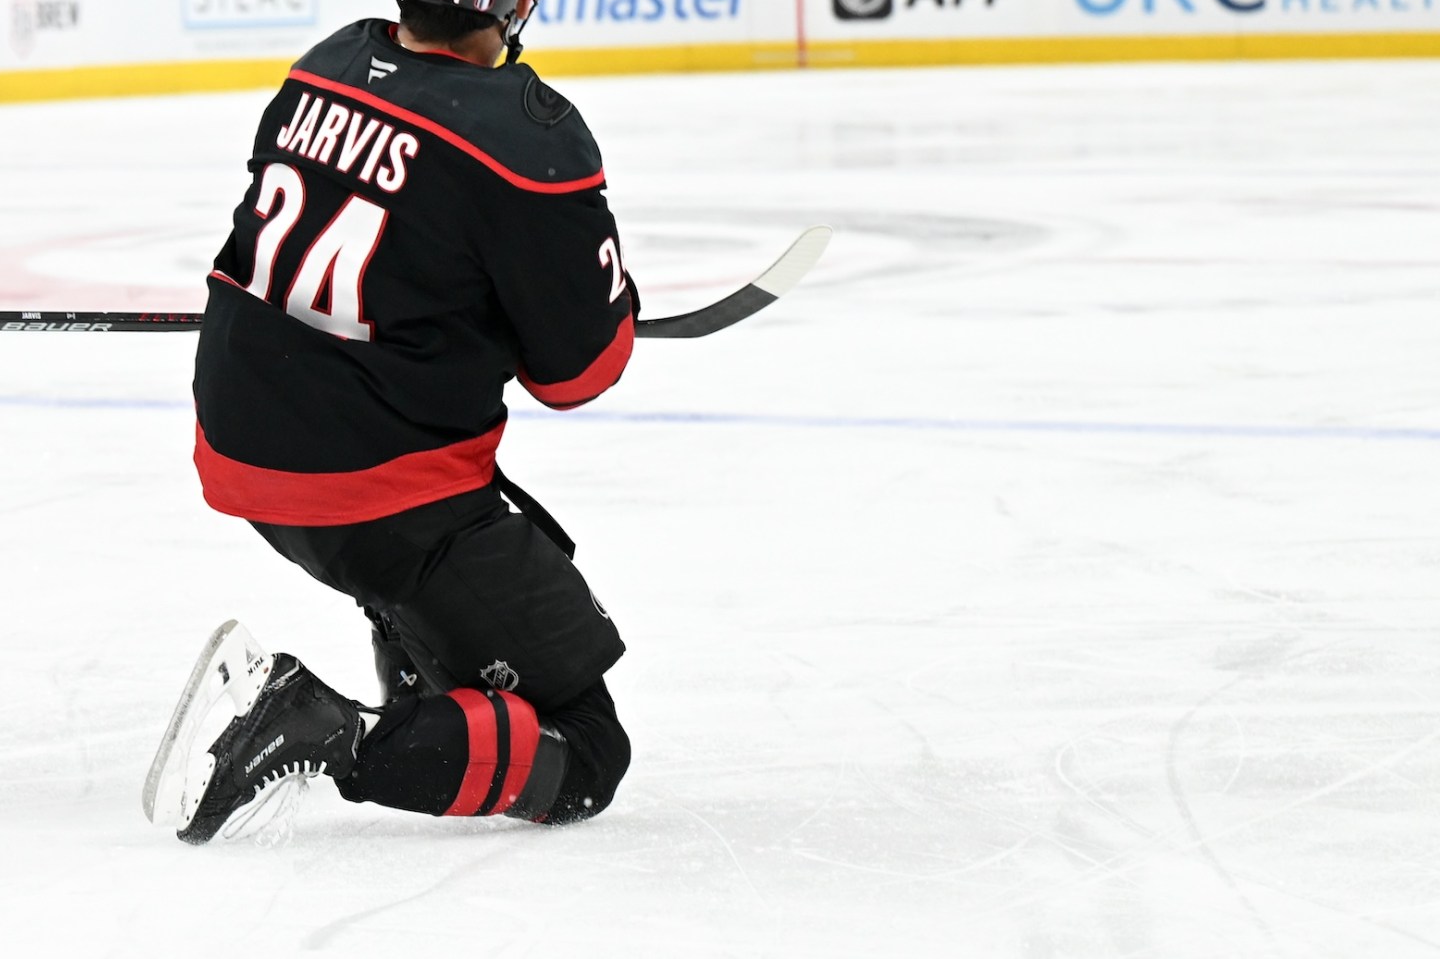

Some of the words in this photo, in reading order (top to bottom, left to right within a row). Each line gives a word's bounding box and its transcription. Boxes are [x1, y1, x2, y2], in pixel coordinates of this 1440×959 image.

[275, 91, 421, 195] JARVIS
[252, 161, 390, 344] 24
[1, 321, 113, 332] BAUER
[243, 733, 286, 777] BAUER
